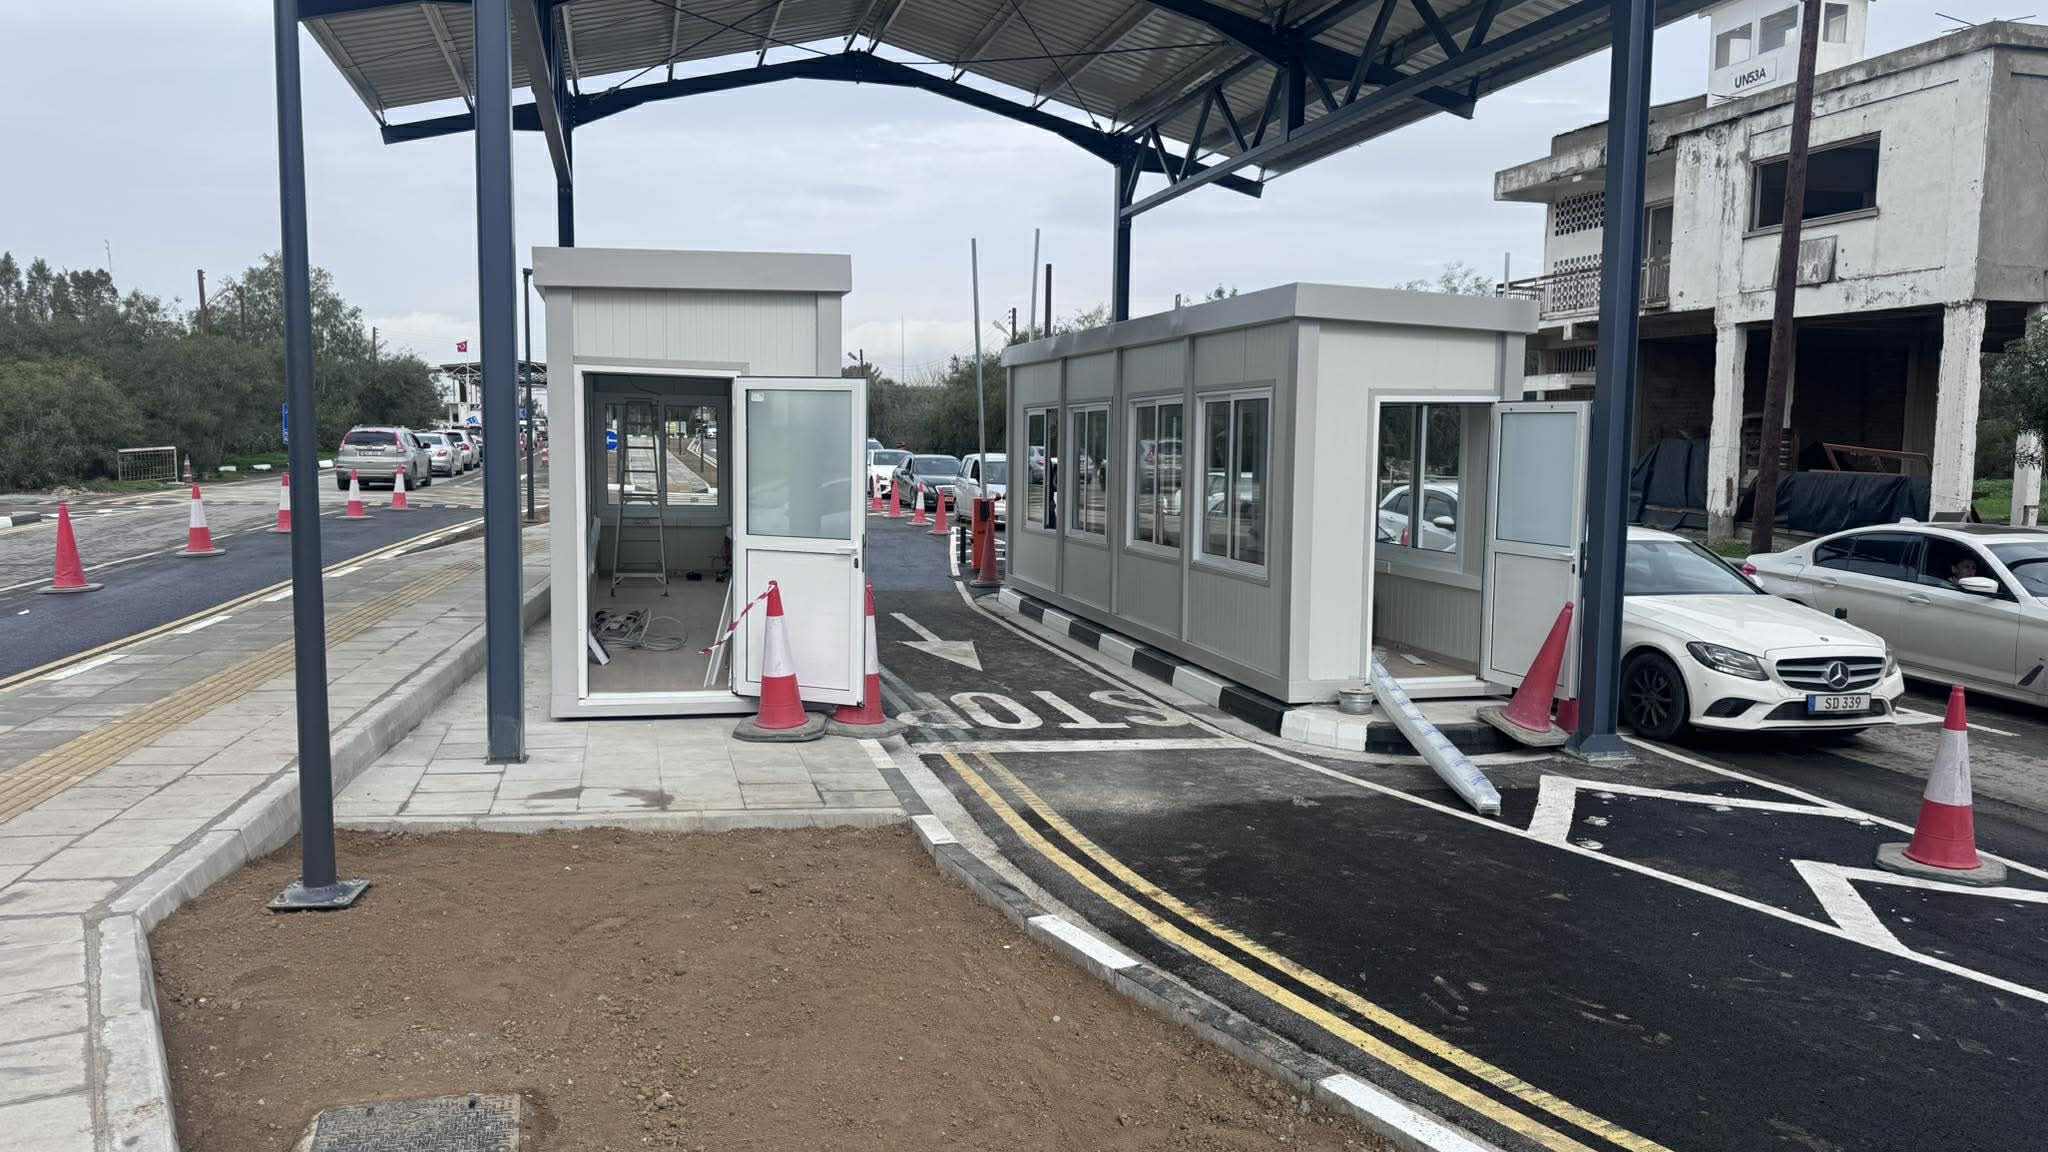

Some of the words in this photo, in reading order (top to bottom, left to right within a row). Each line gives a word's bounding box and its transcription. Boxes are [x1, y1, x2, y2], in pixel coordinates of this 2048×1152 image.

[1734, 67, 1767, 88] UN53A
[896, 690, 1191, 729] STOP
[1824, 697, 1840, 710] SD
[1842, 696, 1862, 709] 339
